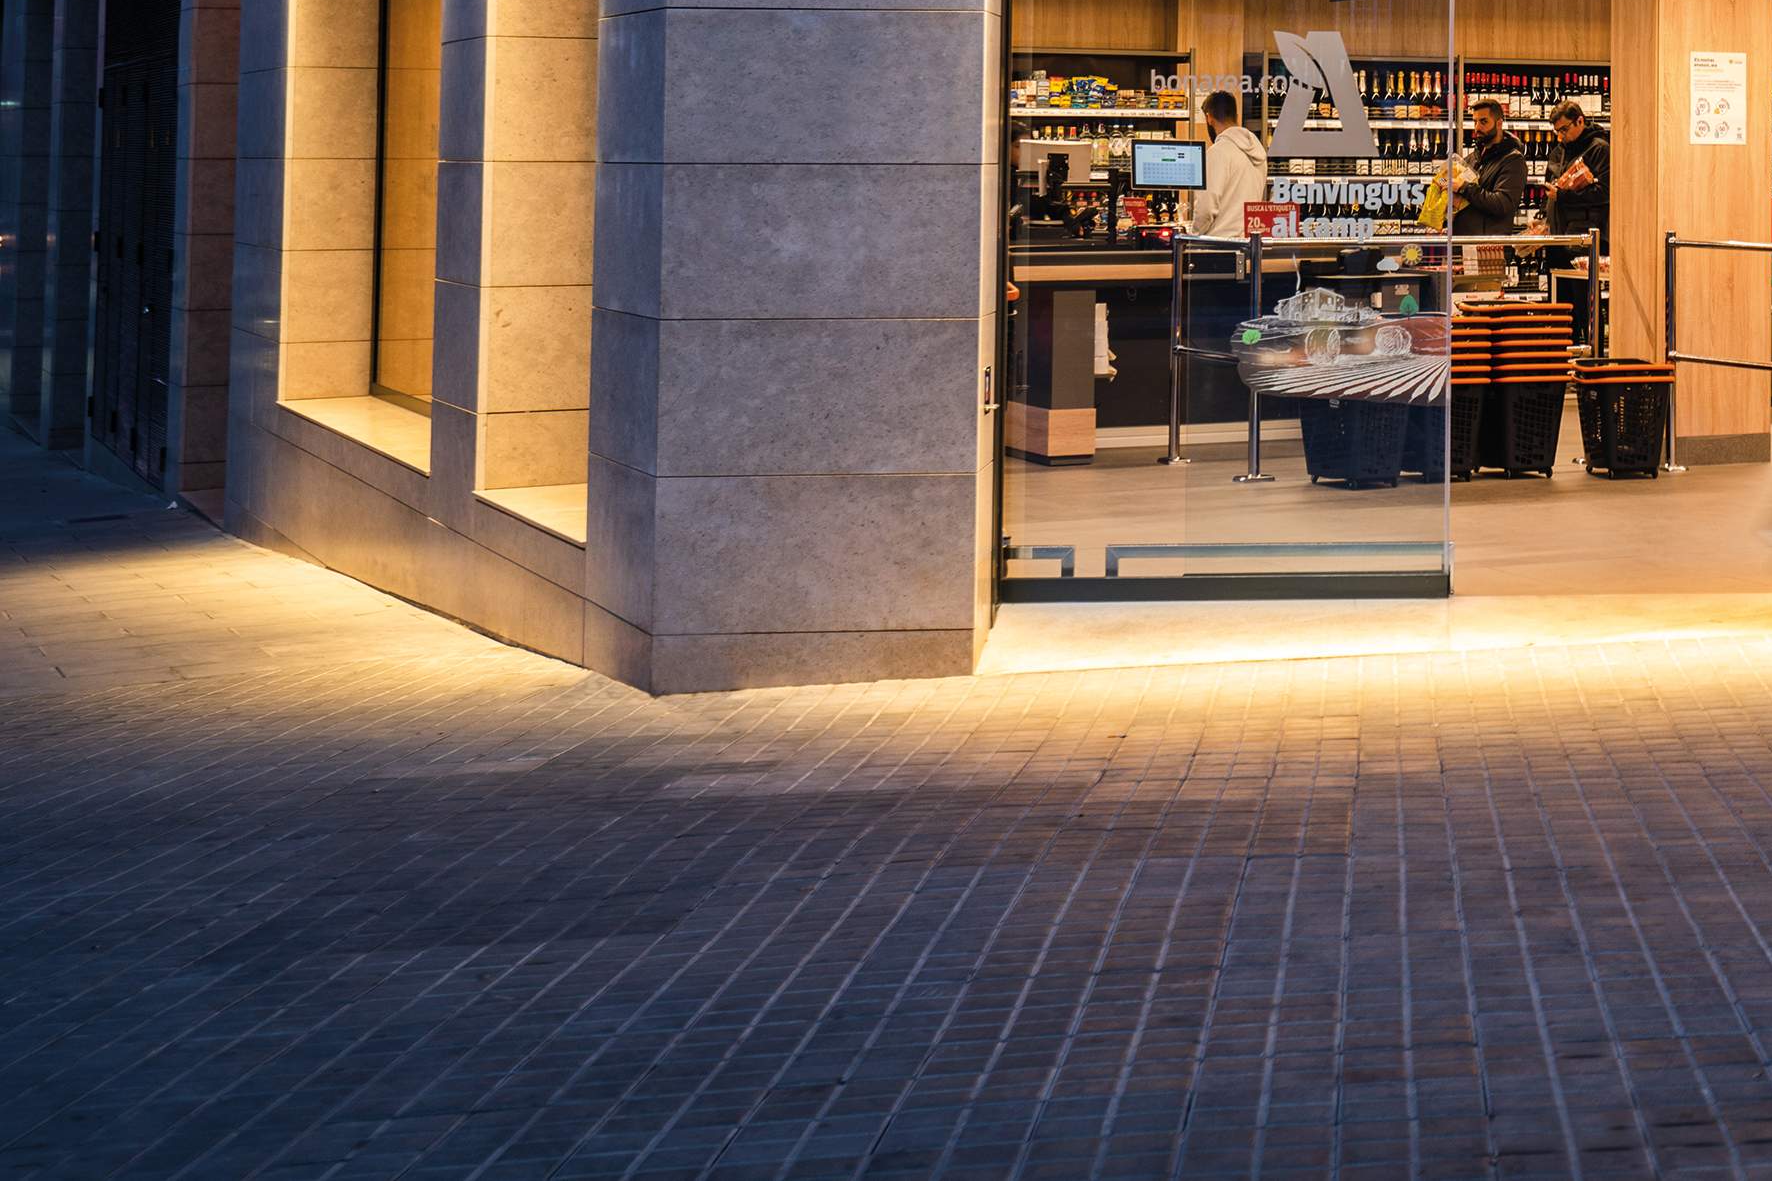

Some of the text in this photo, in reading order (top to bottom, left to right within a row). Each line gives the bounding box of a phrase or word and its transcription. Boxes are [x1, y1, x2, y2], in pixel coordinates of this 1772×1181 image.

[1151, 69, 1314, 93] bonarea.co
[1271, 177, 1425, 210] Benvinguts
[1247, 204, 1265, 212] BUSCA
[1272, 211, 1374, 244] al camp
